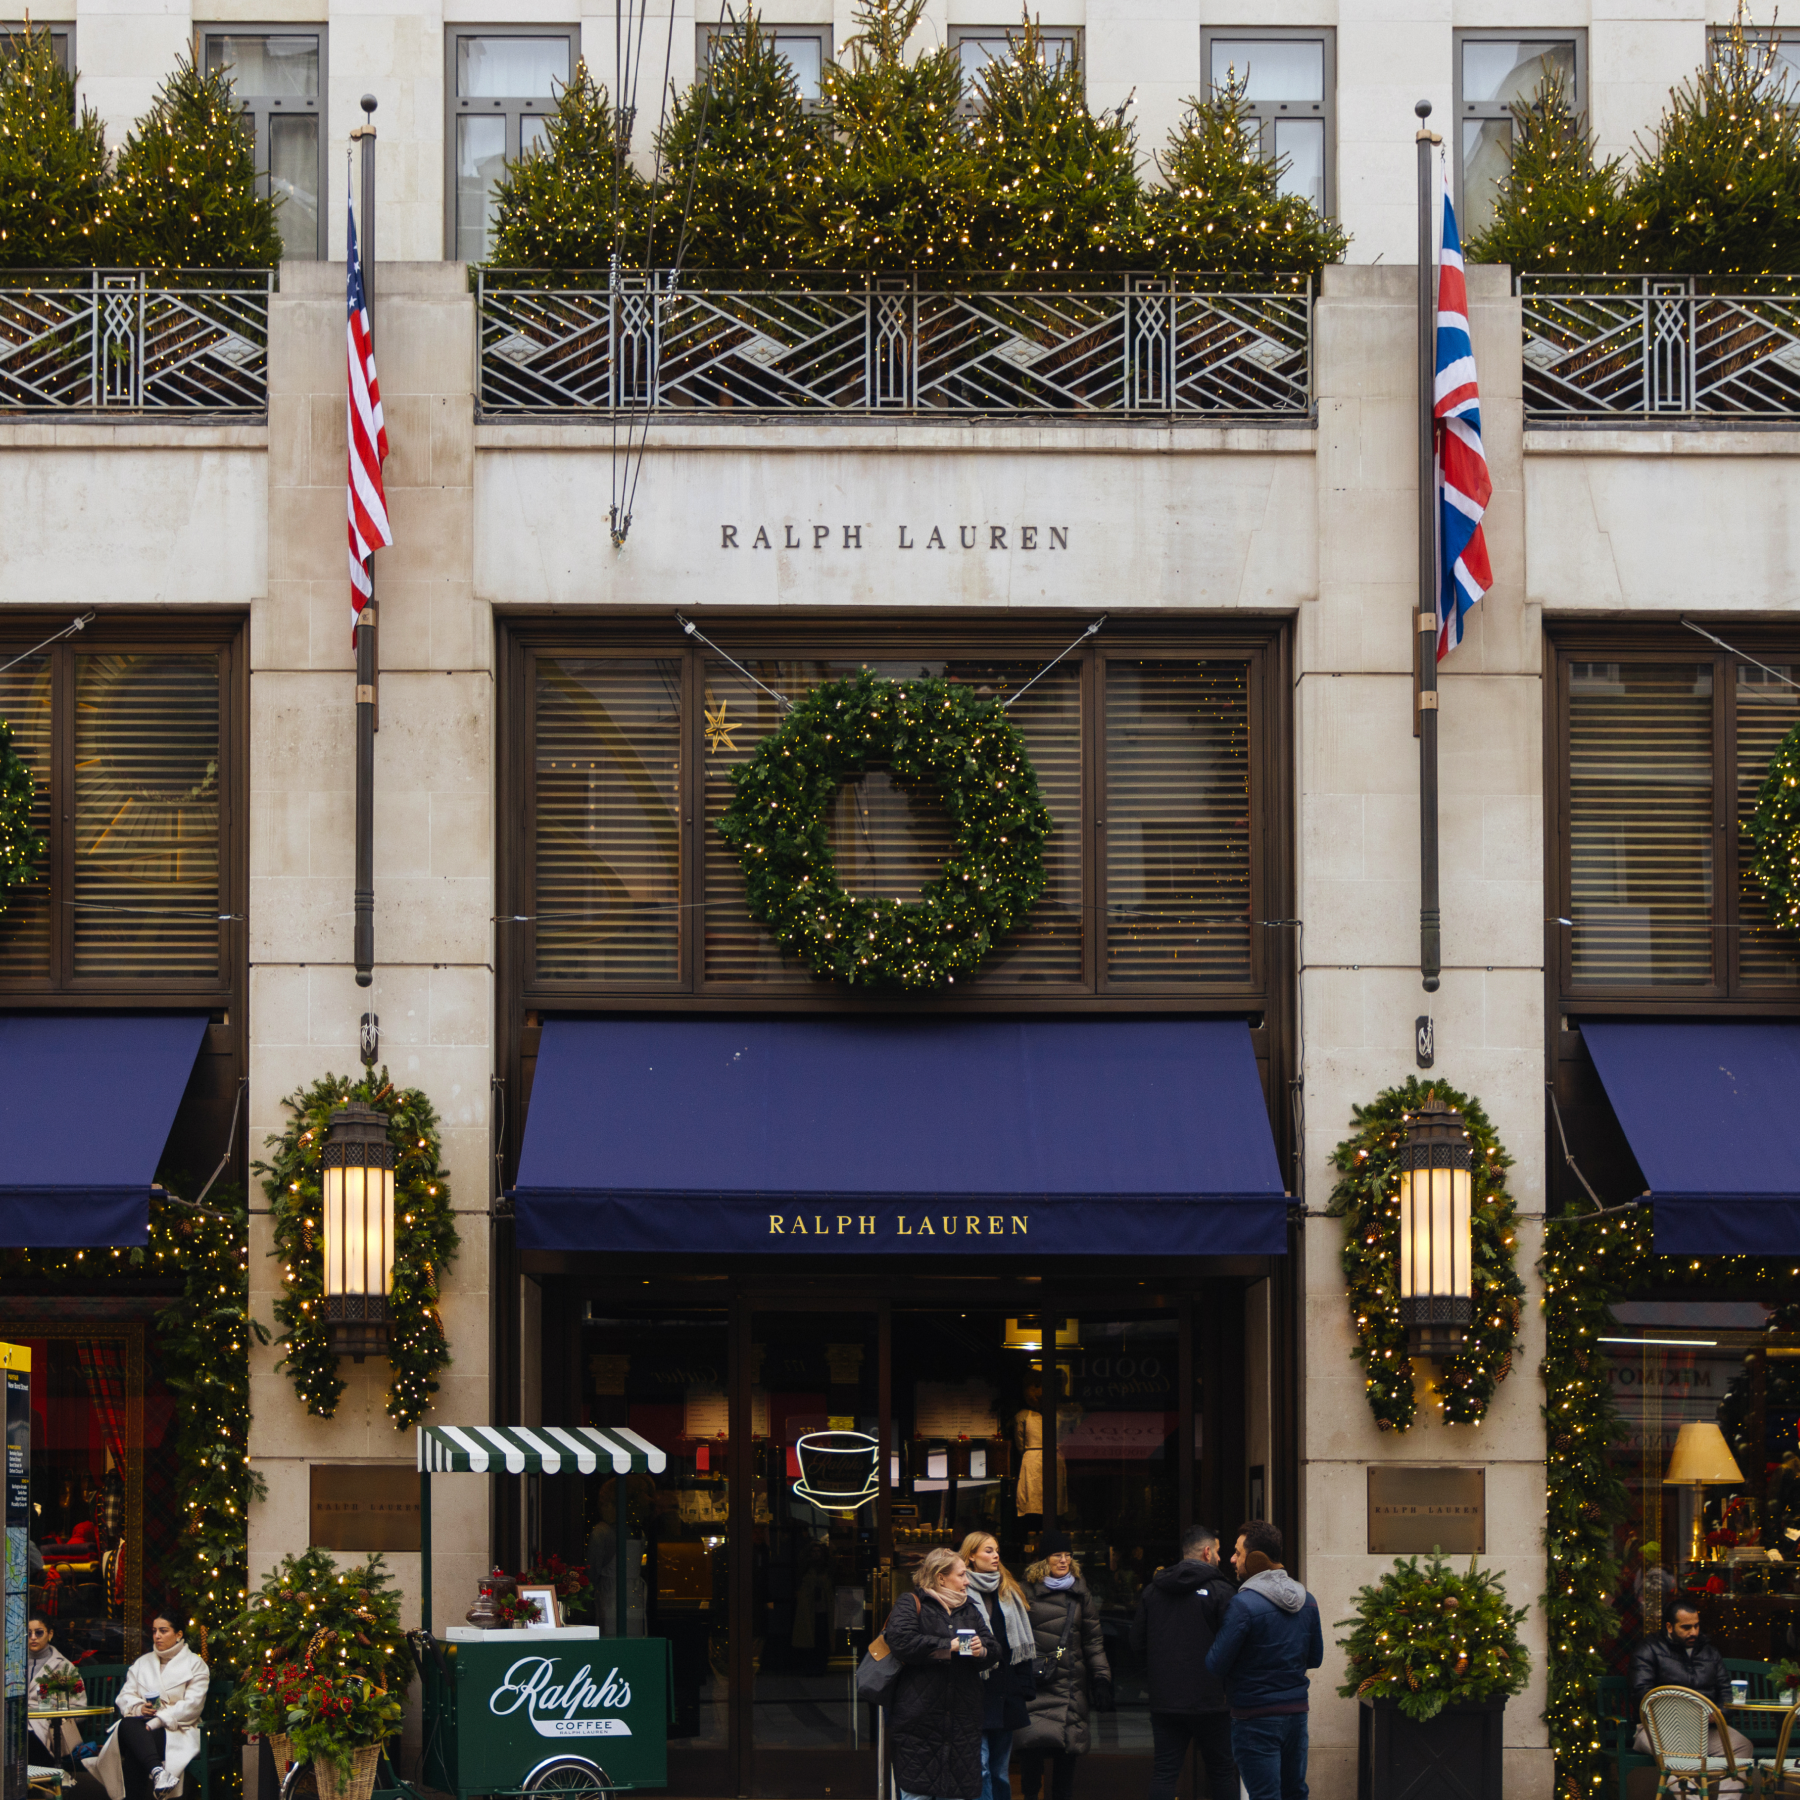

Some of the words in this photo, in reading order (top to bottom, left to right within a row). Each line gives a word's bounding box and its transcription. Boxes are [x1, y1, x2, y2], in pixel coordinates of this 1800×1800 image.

[720, 524, 862, 549] RALPH
[898, 525, 1069, 550] LAUREN
[769, 1215, 876, 1234] RALPH
[897, 1215, 1029, 1235] LAUREN
[317, 1503, 358, 1511] RALPH
[370, 1503, 420, 1511] LAUREN
[1428, 1506, 1479, 1514] LAUREN
[489, 1655, 632, 1720] Ralph's
[555, 1721, 613, 1731] COFFEE
